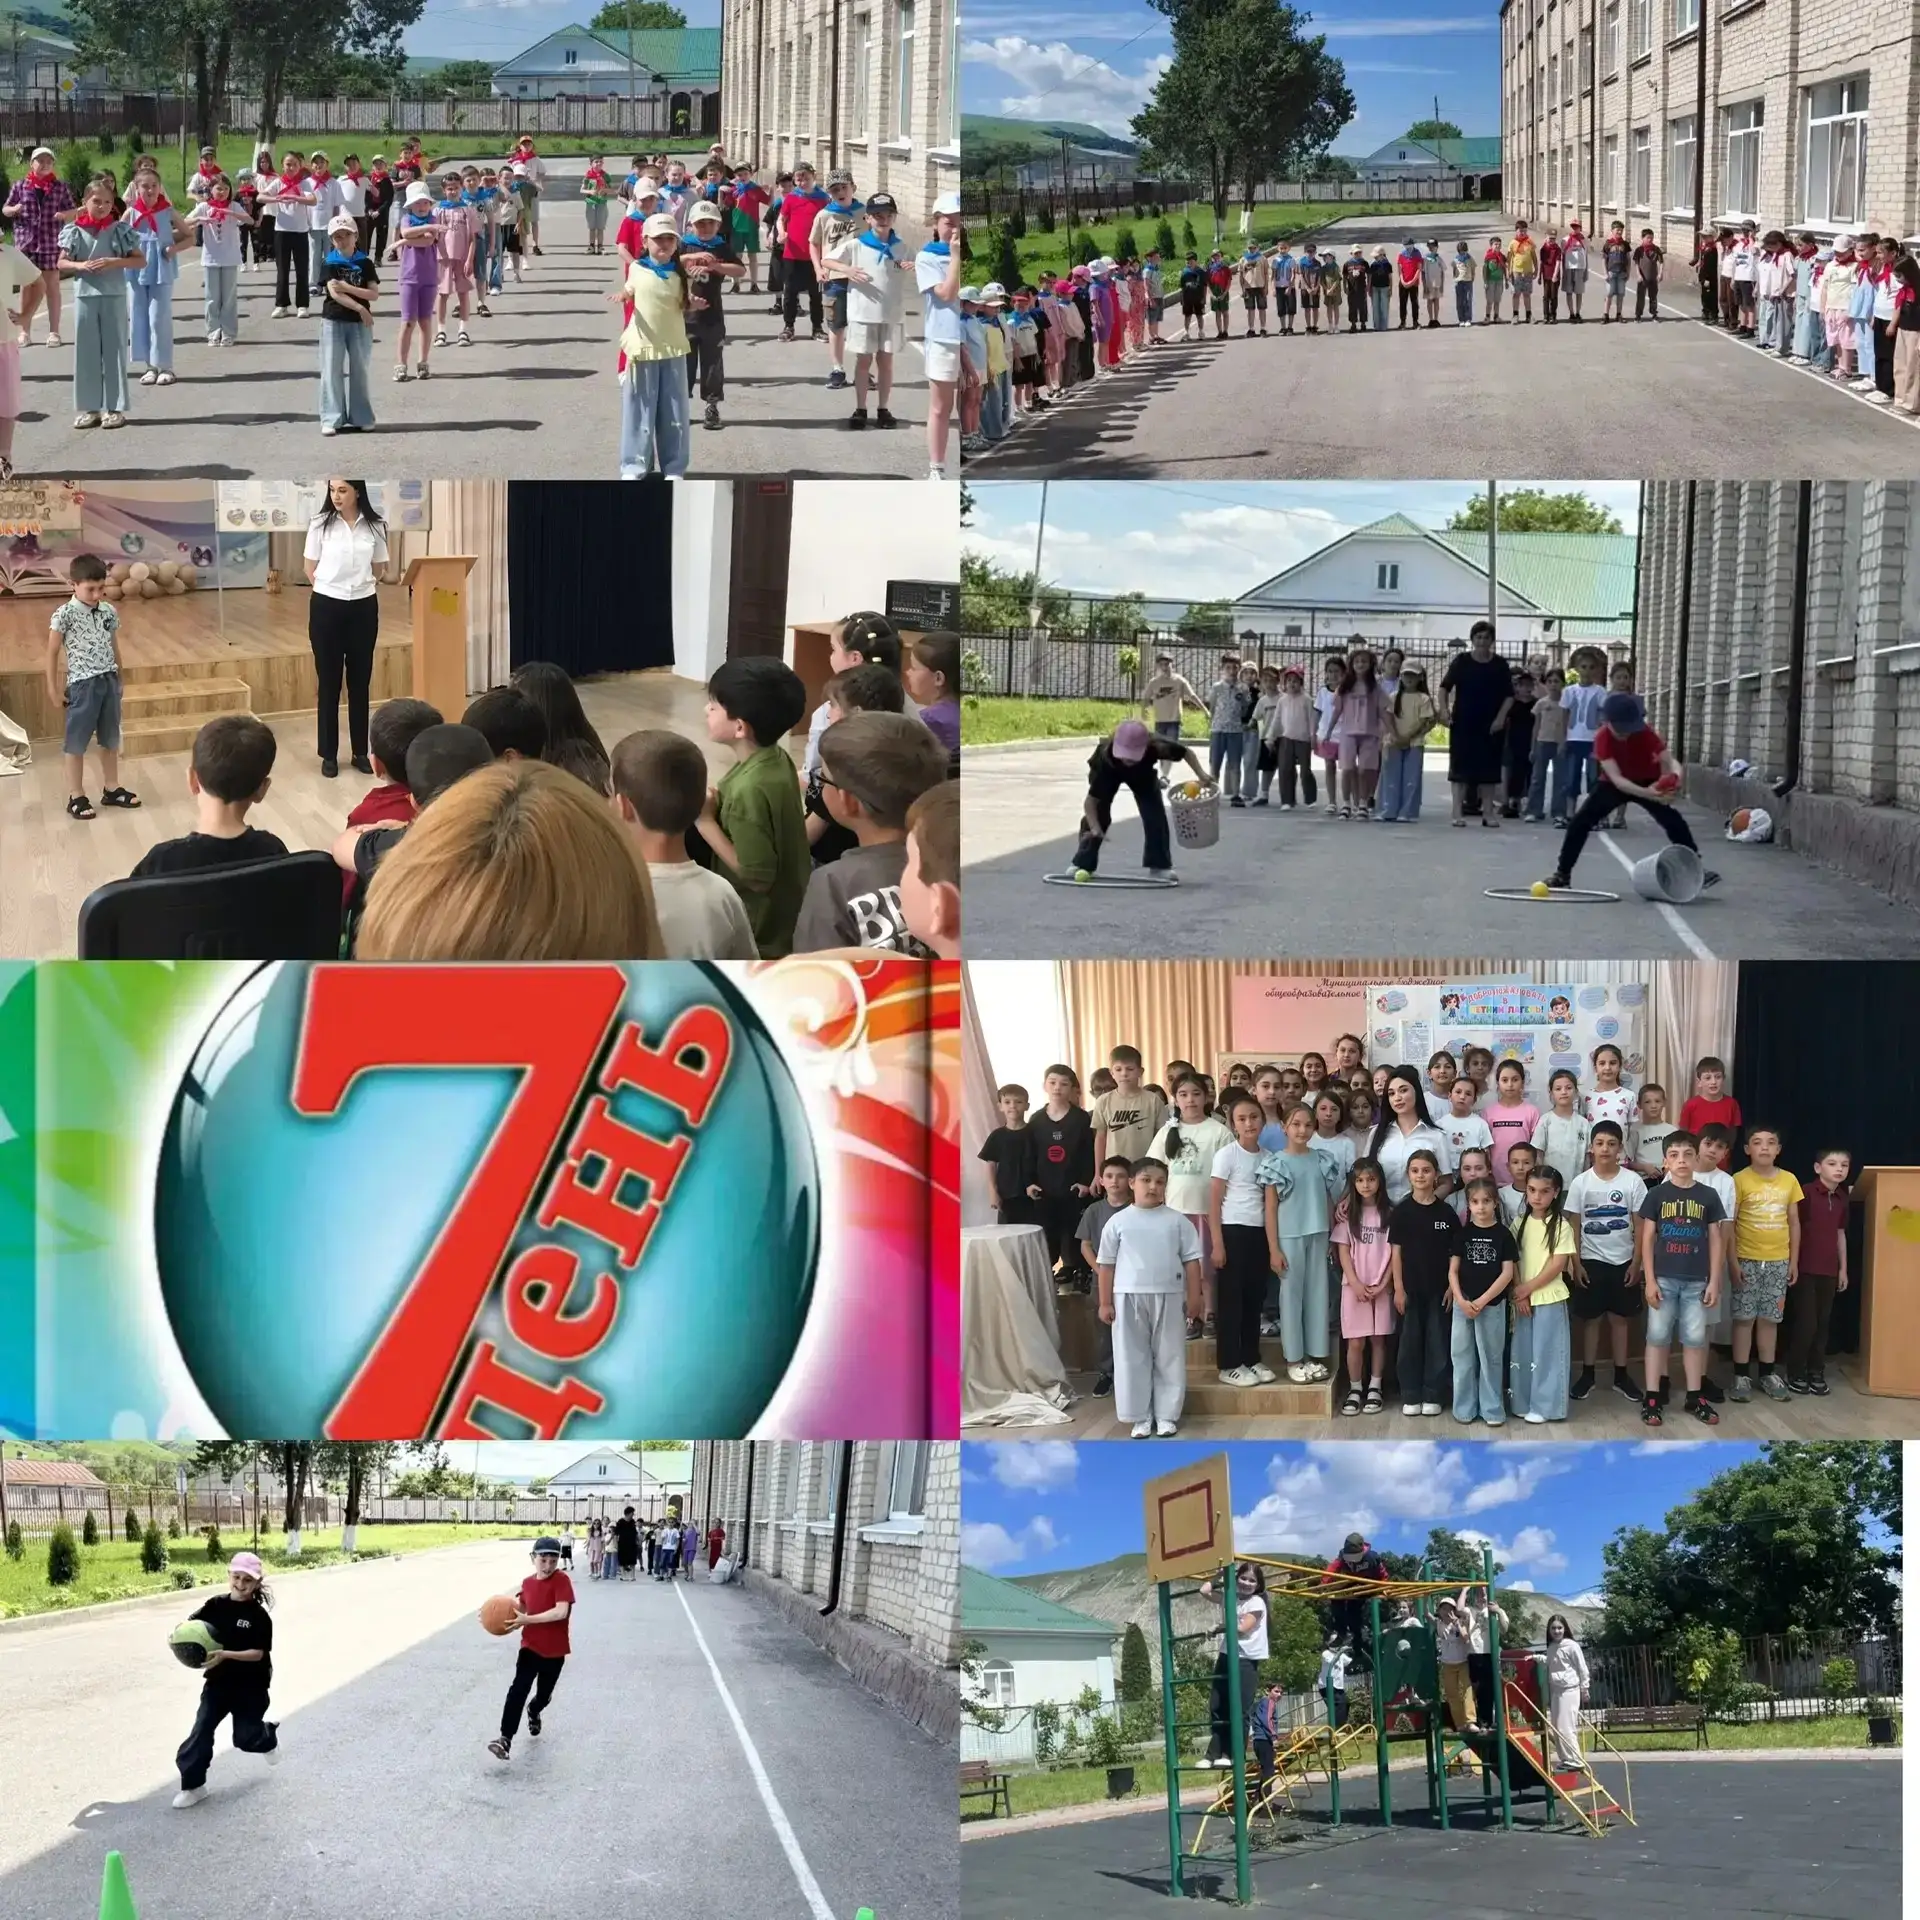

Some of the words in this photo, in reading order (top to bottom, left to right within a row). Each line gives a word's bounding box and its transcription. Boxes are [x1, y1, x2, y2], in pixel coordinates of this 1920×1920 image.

[832, 221, 856, 234] NIKE
[1264, 987, 1361, 1000] общеобразовательное
[1112, 1110, 1140, 1122] NIKE
[291, 963, 628, 1440] 7
[1662, 1199, 1684, 1219] DON'T
[1686, 1199, 1705, 1220] WAIT
[1362, 1232, 1374, 1244] 80
